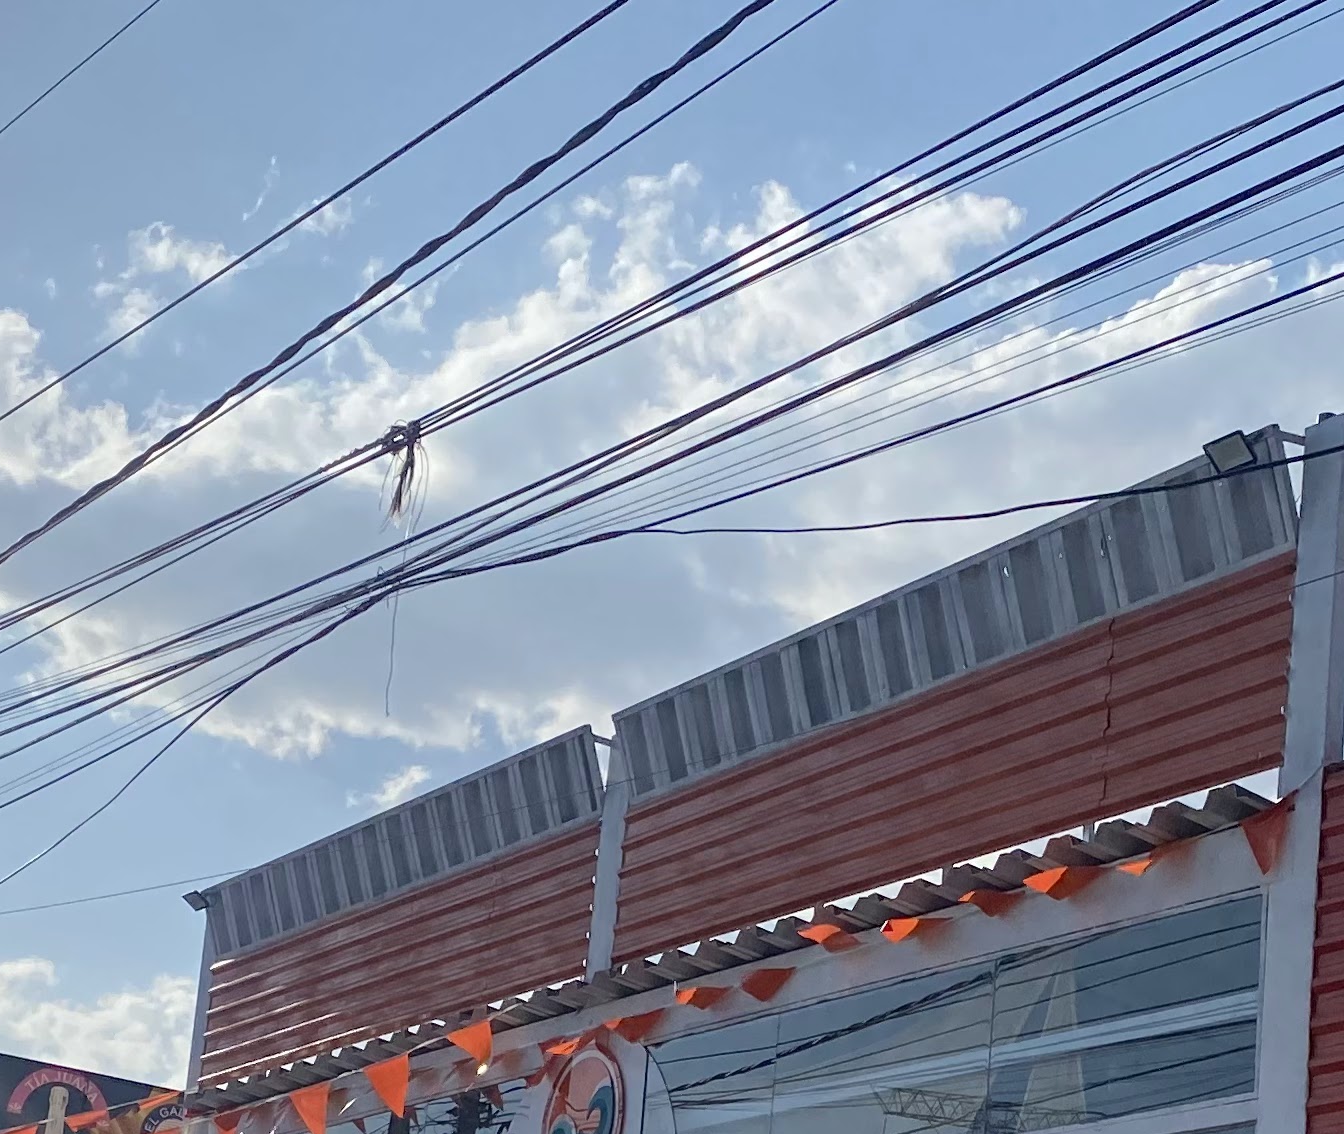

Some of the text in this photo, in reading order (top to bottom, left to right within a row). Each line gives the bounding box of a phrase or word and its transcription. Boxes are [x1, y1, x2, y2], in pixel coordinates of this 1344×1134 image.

[24, 1071, 100, 1103] TÍA JUANA
[144, 1117, 160, 1132] EL
